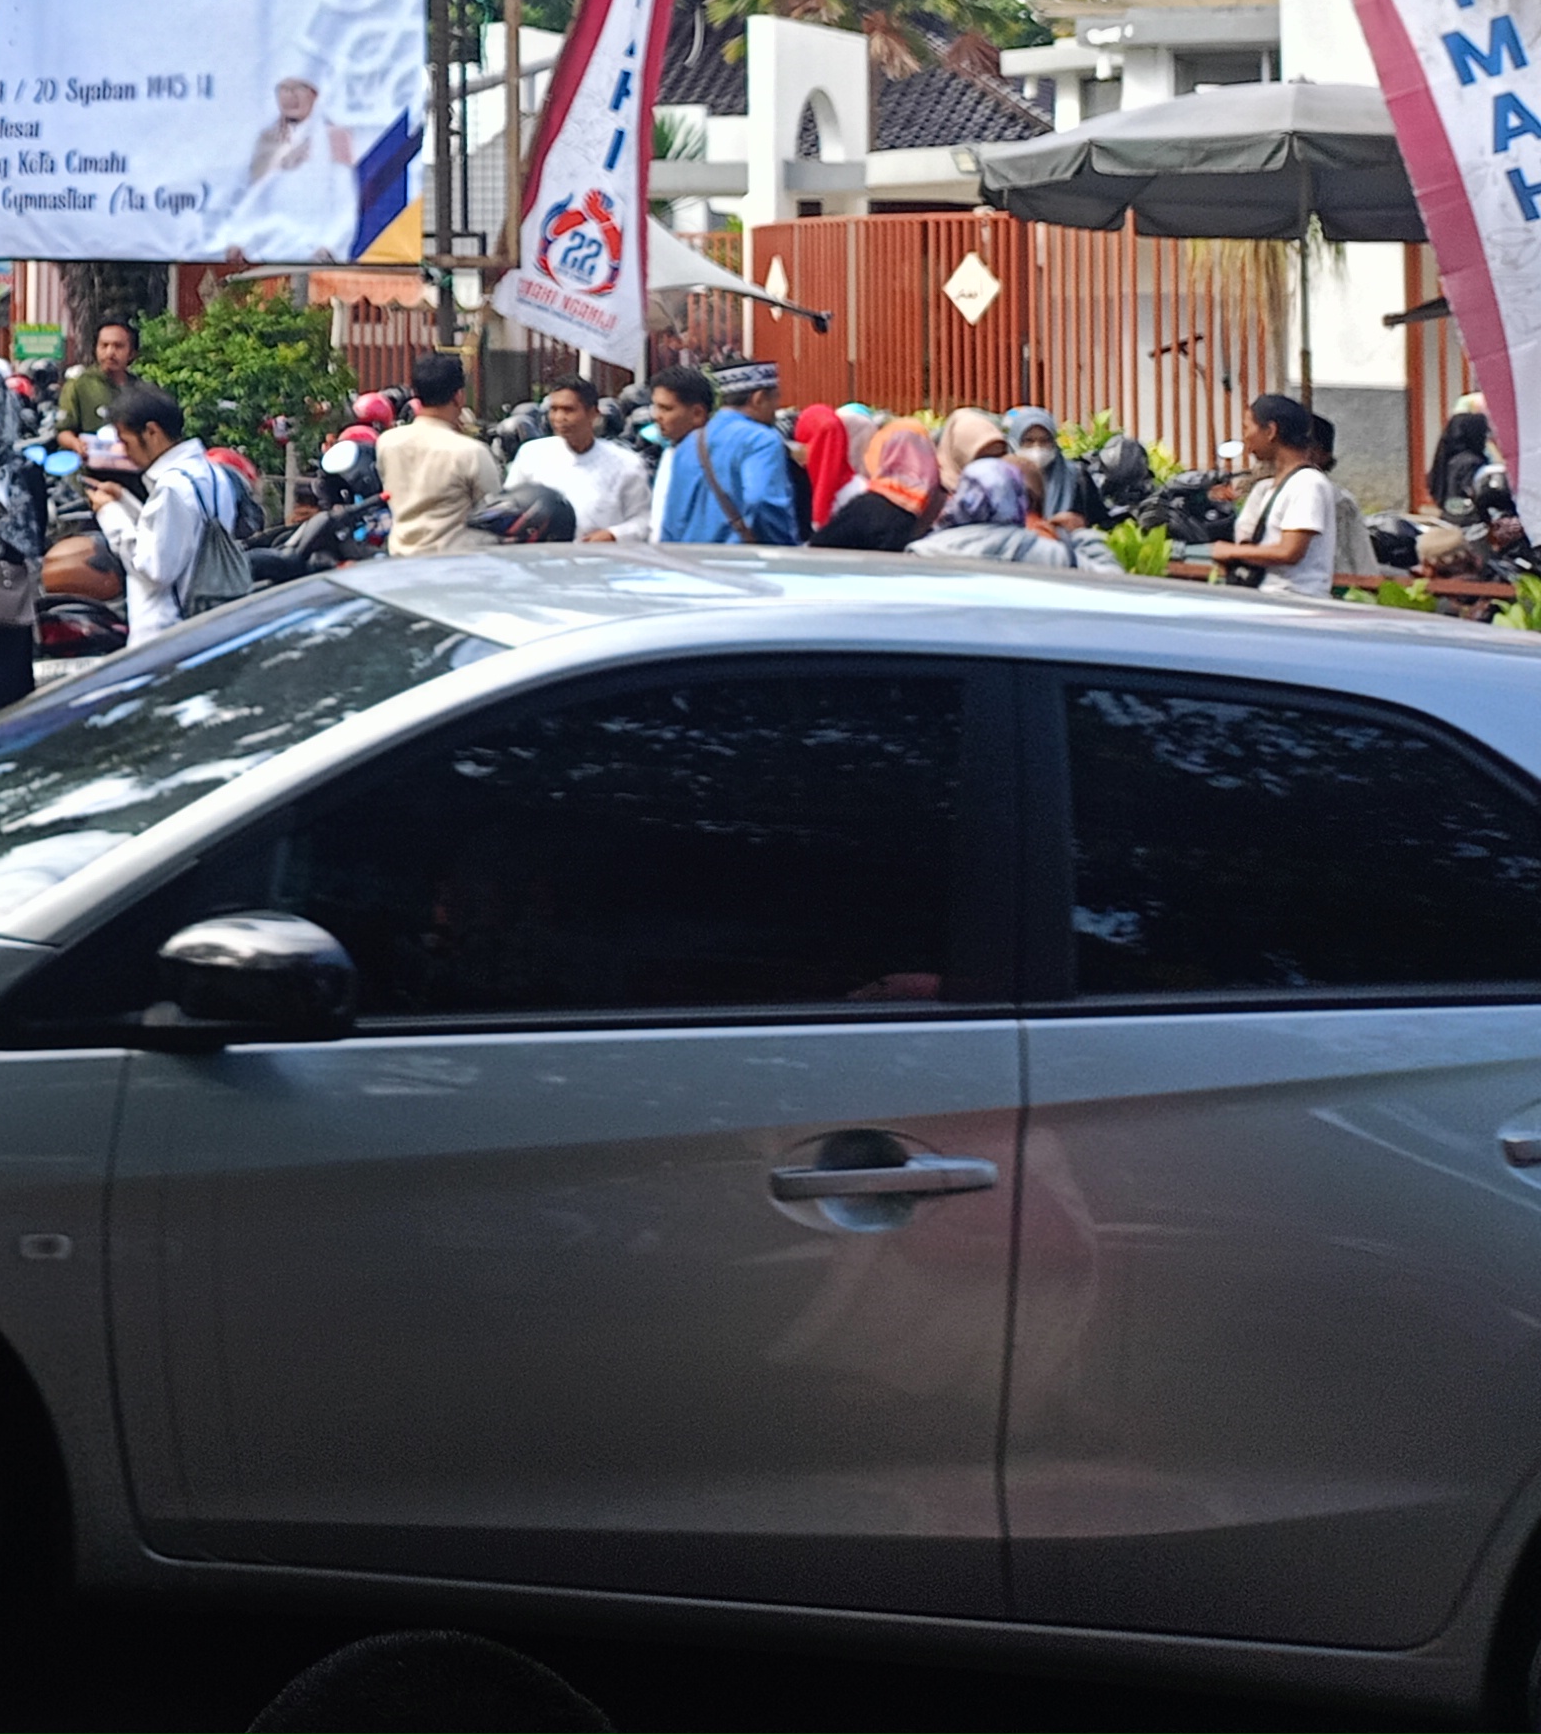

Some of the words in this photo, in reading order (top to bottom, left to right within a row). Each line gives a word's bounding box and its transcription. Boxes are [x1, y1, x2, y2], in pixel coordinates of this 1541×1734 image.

[33, 77, 57, 104] 20
[65, 75, 137, 107] Syaban
[65, 149, 128, 174] Cimahi
[559, 230, 604, 277] 22
